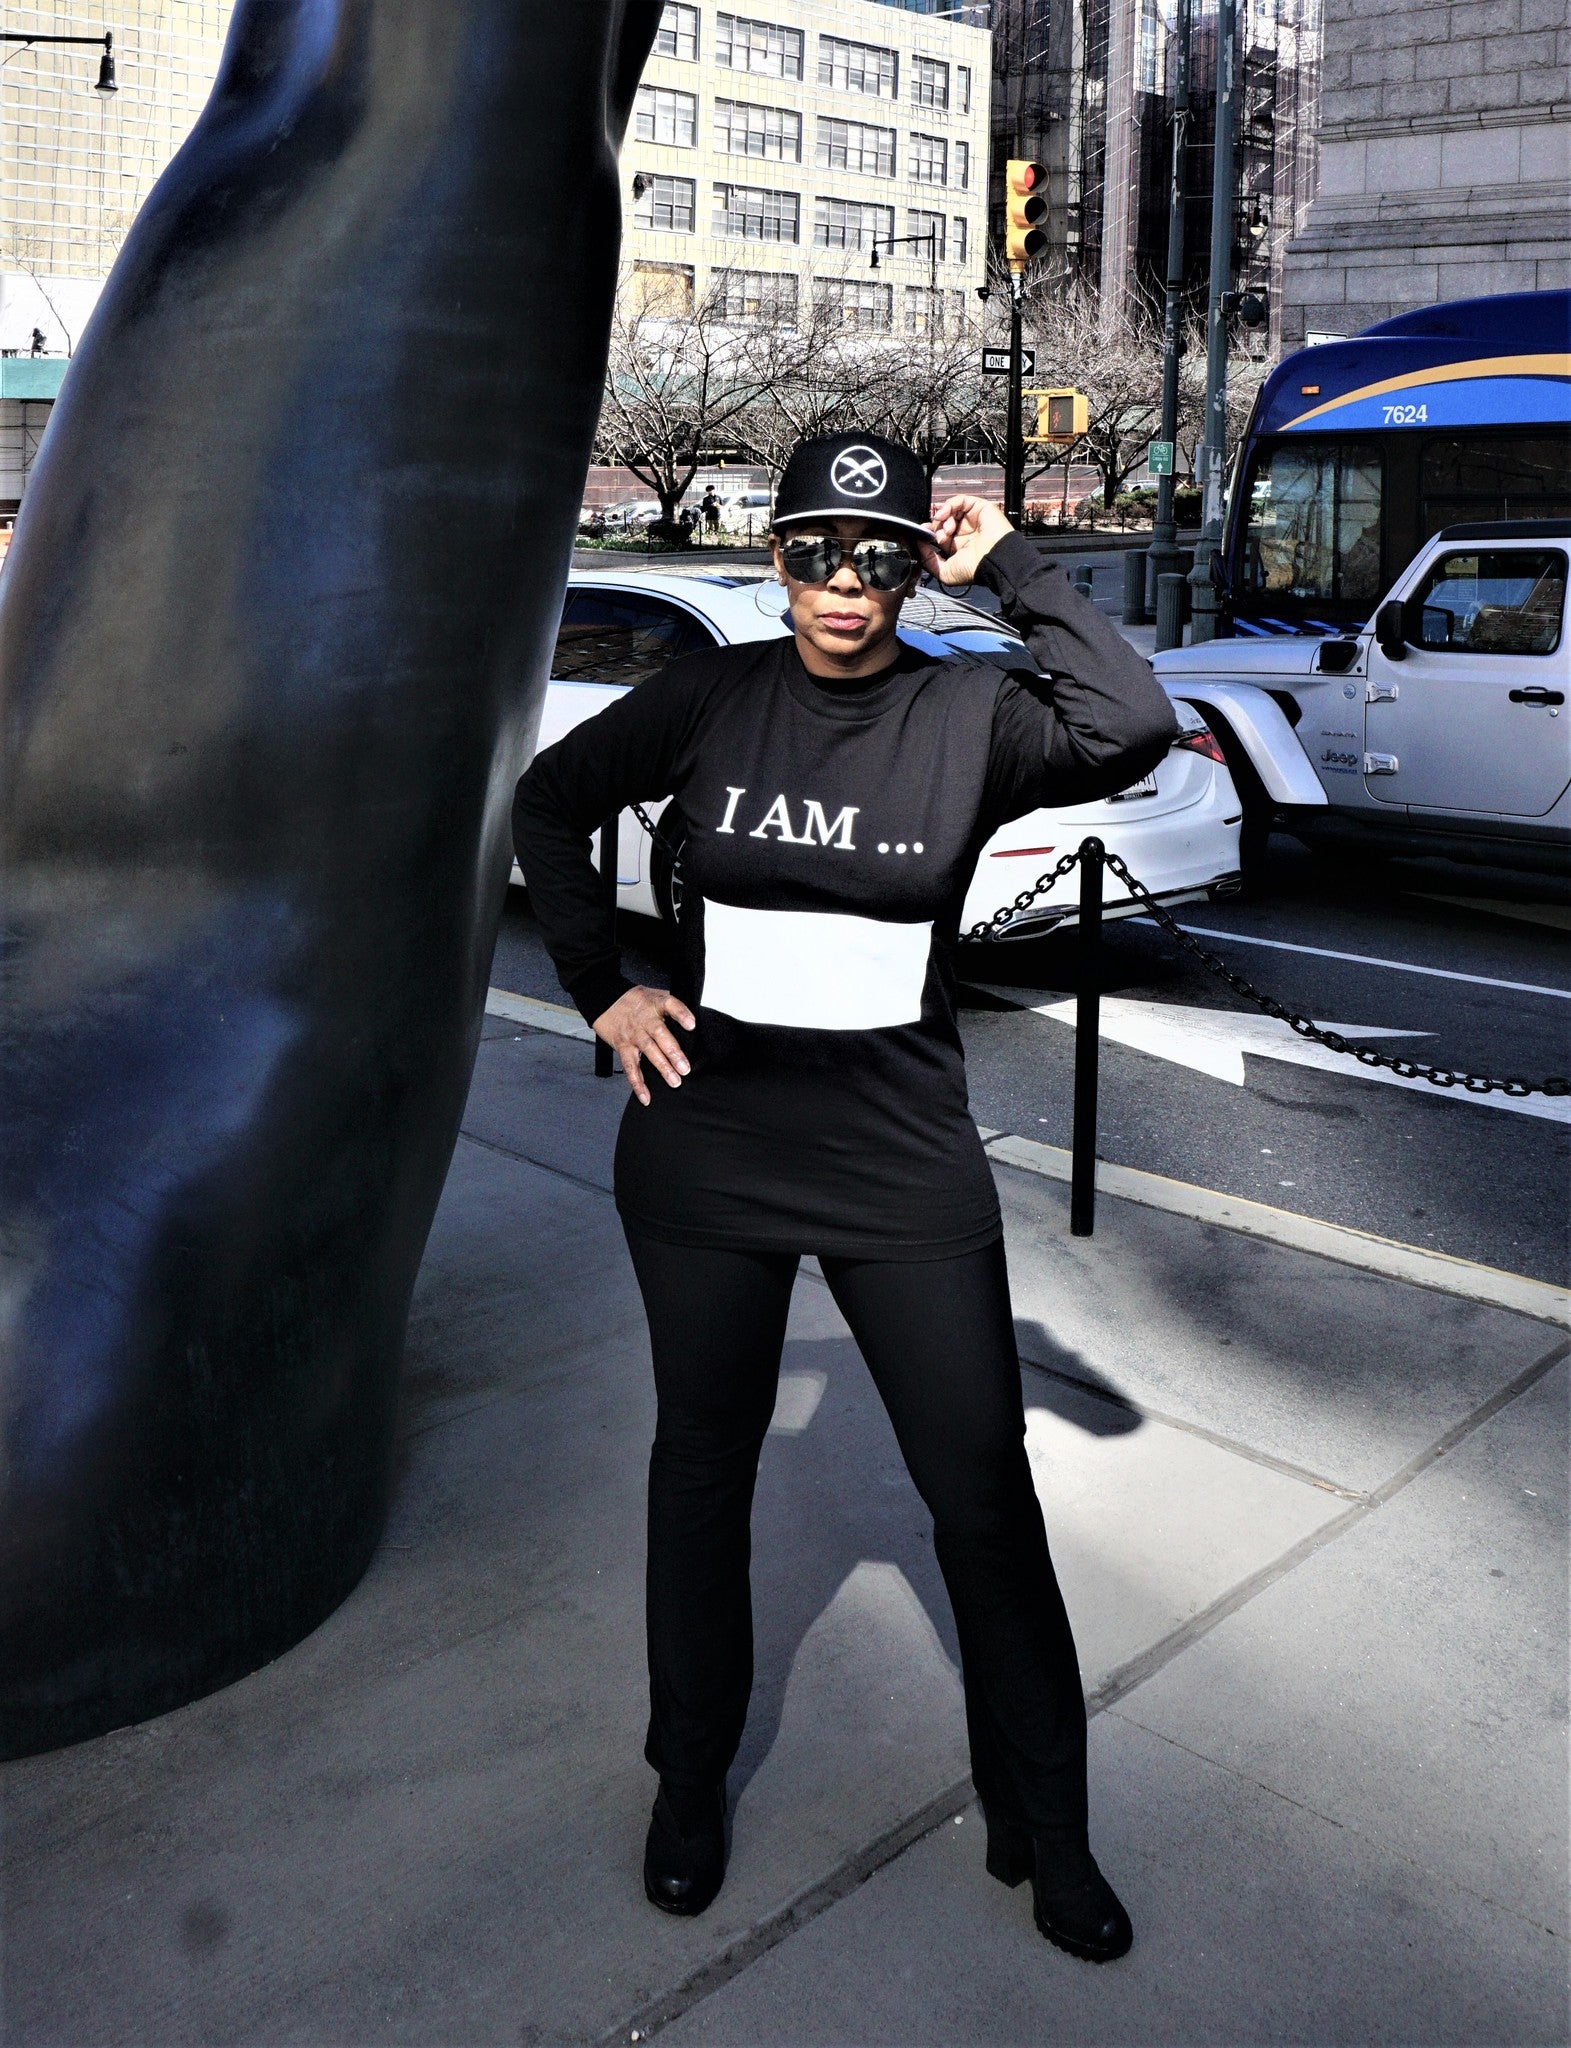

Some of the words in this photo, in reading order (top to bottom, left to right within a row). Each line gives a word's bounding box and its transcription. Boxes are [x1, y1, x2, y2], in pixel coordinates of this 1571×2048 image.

[989, 355, 1005, 368] ONE
[1382, 404, 1428, 424] 7624
[1320, 749, 1358, 767] Jeep
[715, 786, 746, 834] I
[749, 794, 860, 851] AM
